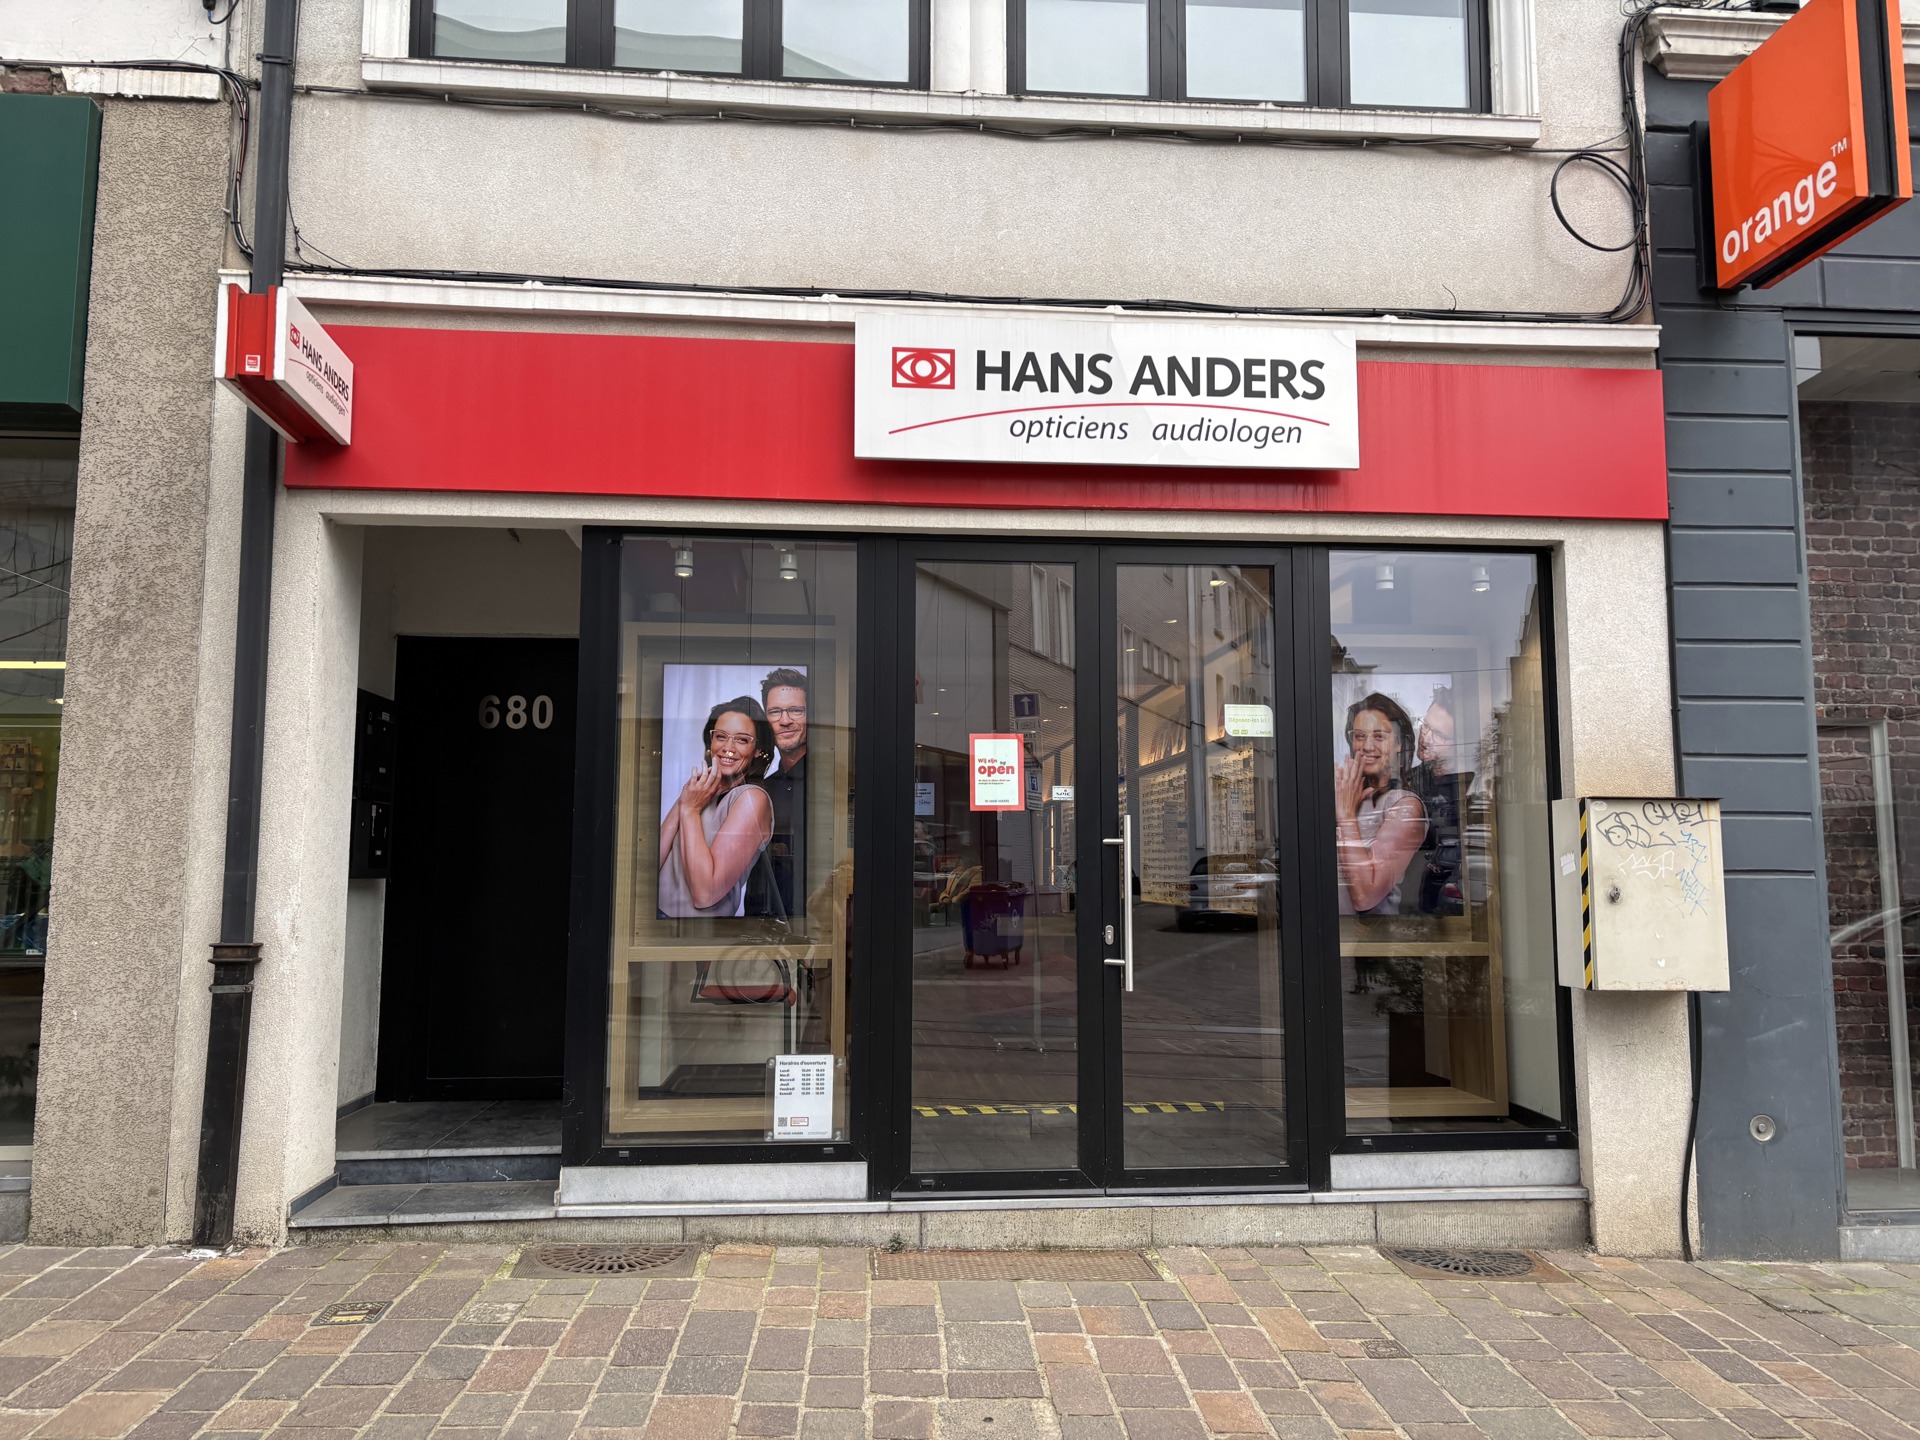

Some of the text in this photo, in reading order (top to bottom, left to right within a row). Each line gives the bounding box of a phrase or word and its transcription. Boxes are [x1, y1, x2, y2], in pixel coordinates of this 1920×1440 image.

[1722, 159, 1838, 264] orange
[301, 336, 350, 402] HANS ANDERS
[975, 348, 1326, 401] HANS ANDERS
[305, 371, 346, 417] opticiens audiologen
[1008, 414, 1303, 450] opticiens audiologen
[477, 693, 555, 730] 680
[977, 765, 1015, 777] open
